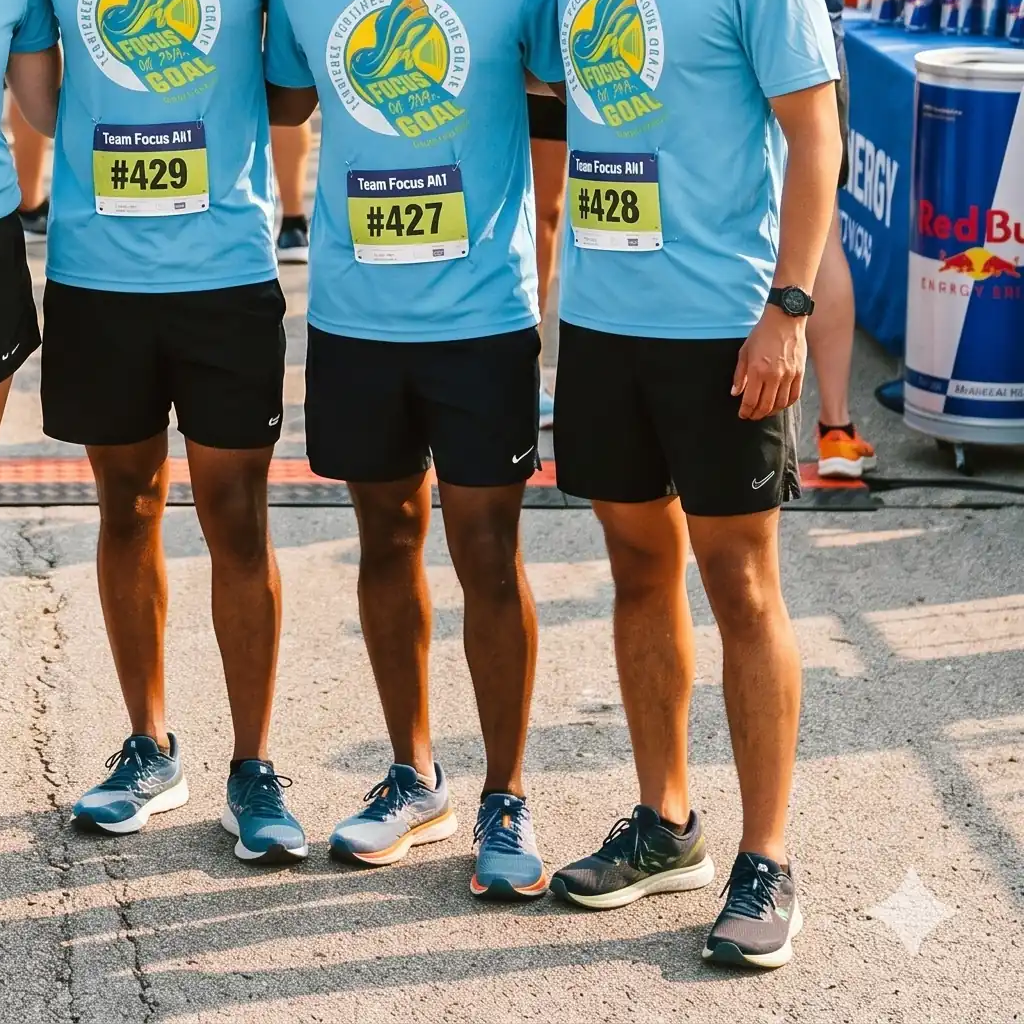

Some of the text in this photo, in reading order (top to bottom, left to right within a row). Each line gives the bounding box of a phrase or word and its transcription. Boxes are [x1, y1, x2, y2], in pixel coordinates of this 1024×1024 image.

[117, 29, 182, 60] FOCUS
[366, 71, 431, 104] FOCUS
[582, 60, 631, 91] FOCUS
[103, 132, 132, 145] Team
[134, 133, 169, 145] Focus
[111, 157, 188, 191] #429
[594, 160, 622, 174] Focus
[357, 177, 387, 191] Team
[388, 177, 424, 190] Focus
[367, 202, 443, 237] #427
[578, 187, 640, 224] #428
[919, 199, 979, 243] Red
